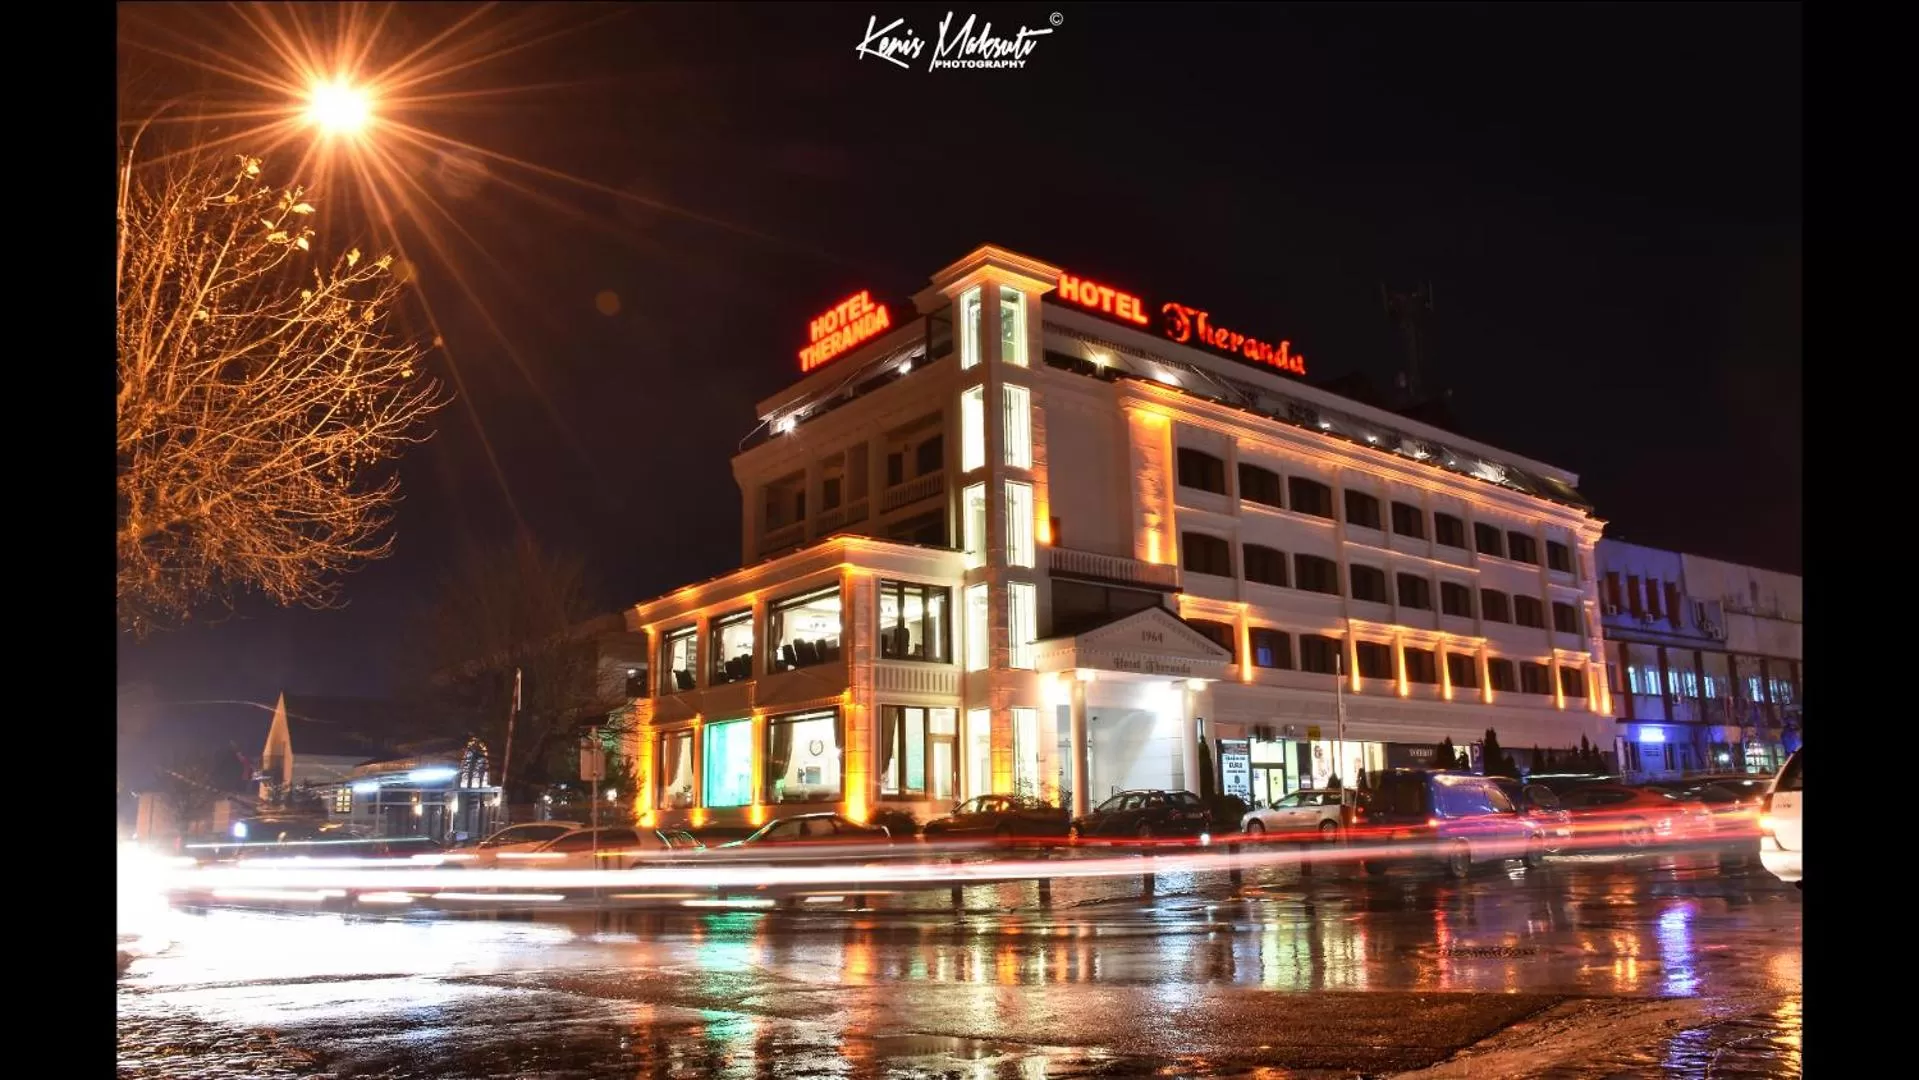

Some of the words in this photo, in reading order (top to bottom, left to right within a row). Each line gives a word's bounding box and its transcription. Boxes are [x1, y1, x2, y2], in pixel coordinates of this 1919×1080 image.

[798, 304, 890, 372] THERANDA
[810, 289, 875, 342] HOTEL
[1058, 274, 1148, 325] HOTEL
[1161, 302, 1306, 376] Theranda
[1113, 657, 1141, 669] Hotel
[1141, 630, 1164, 644] 1964
